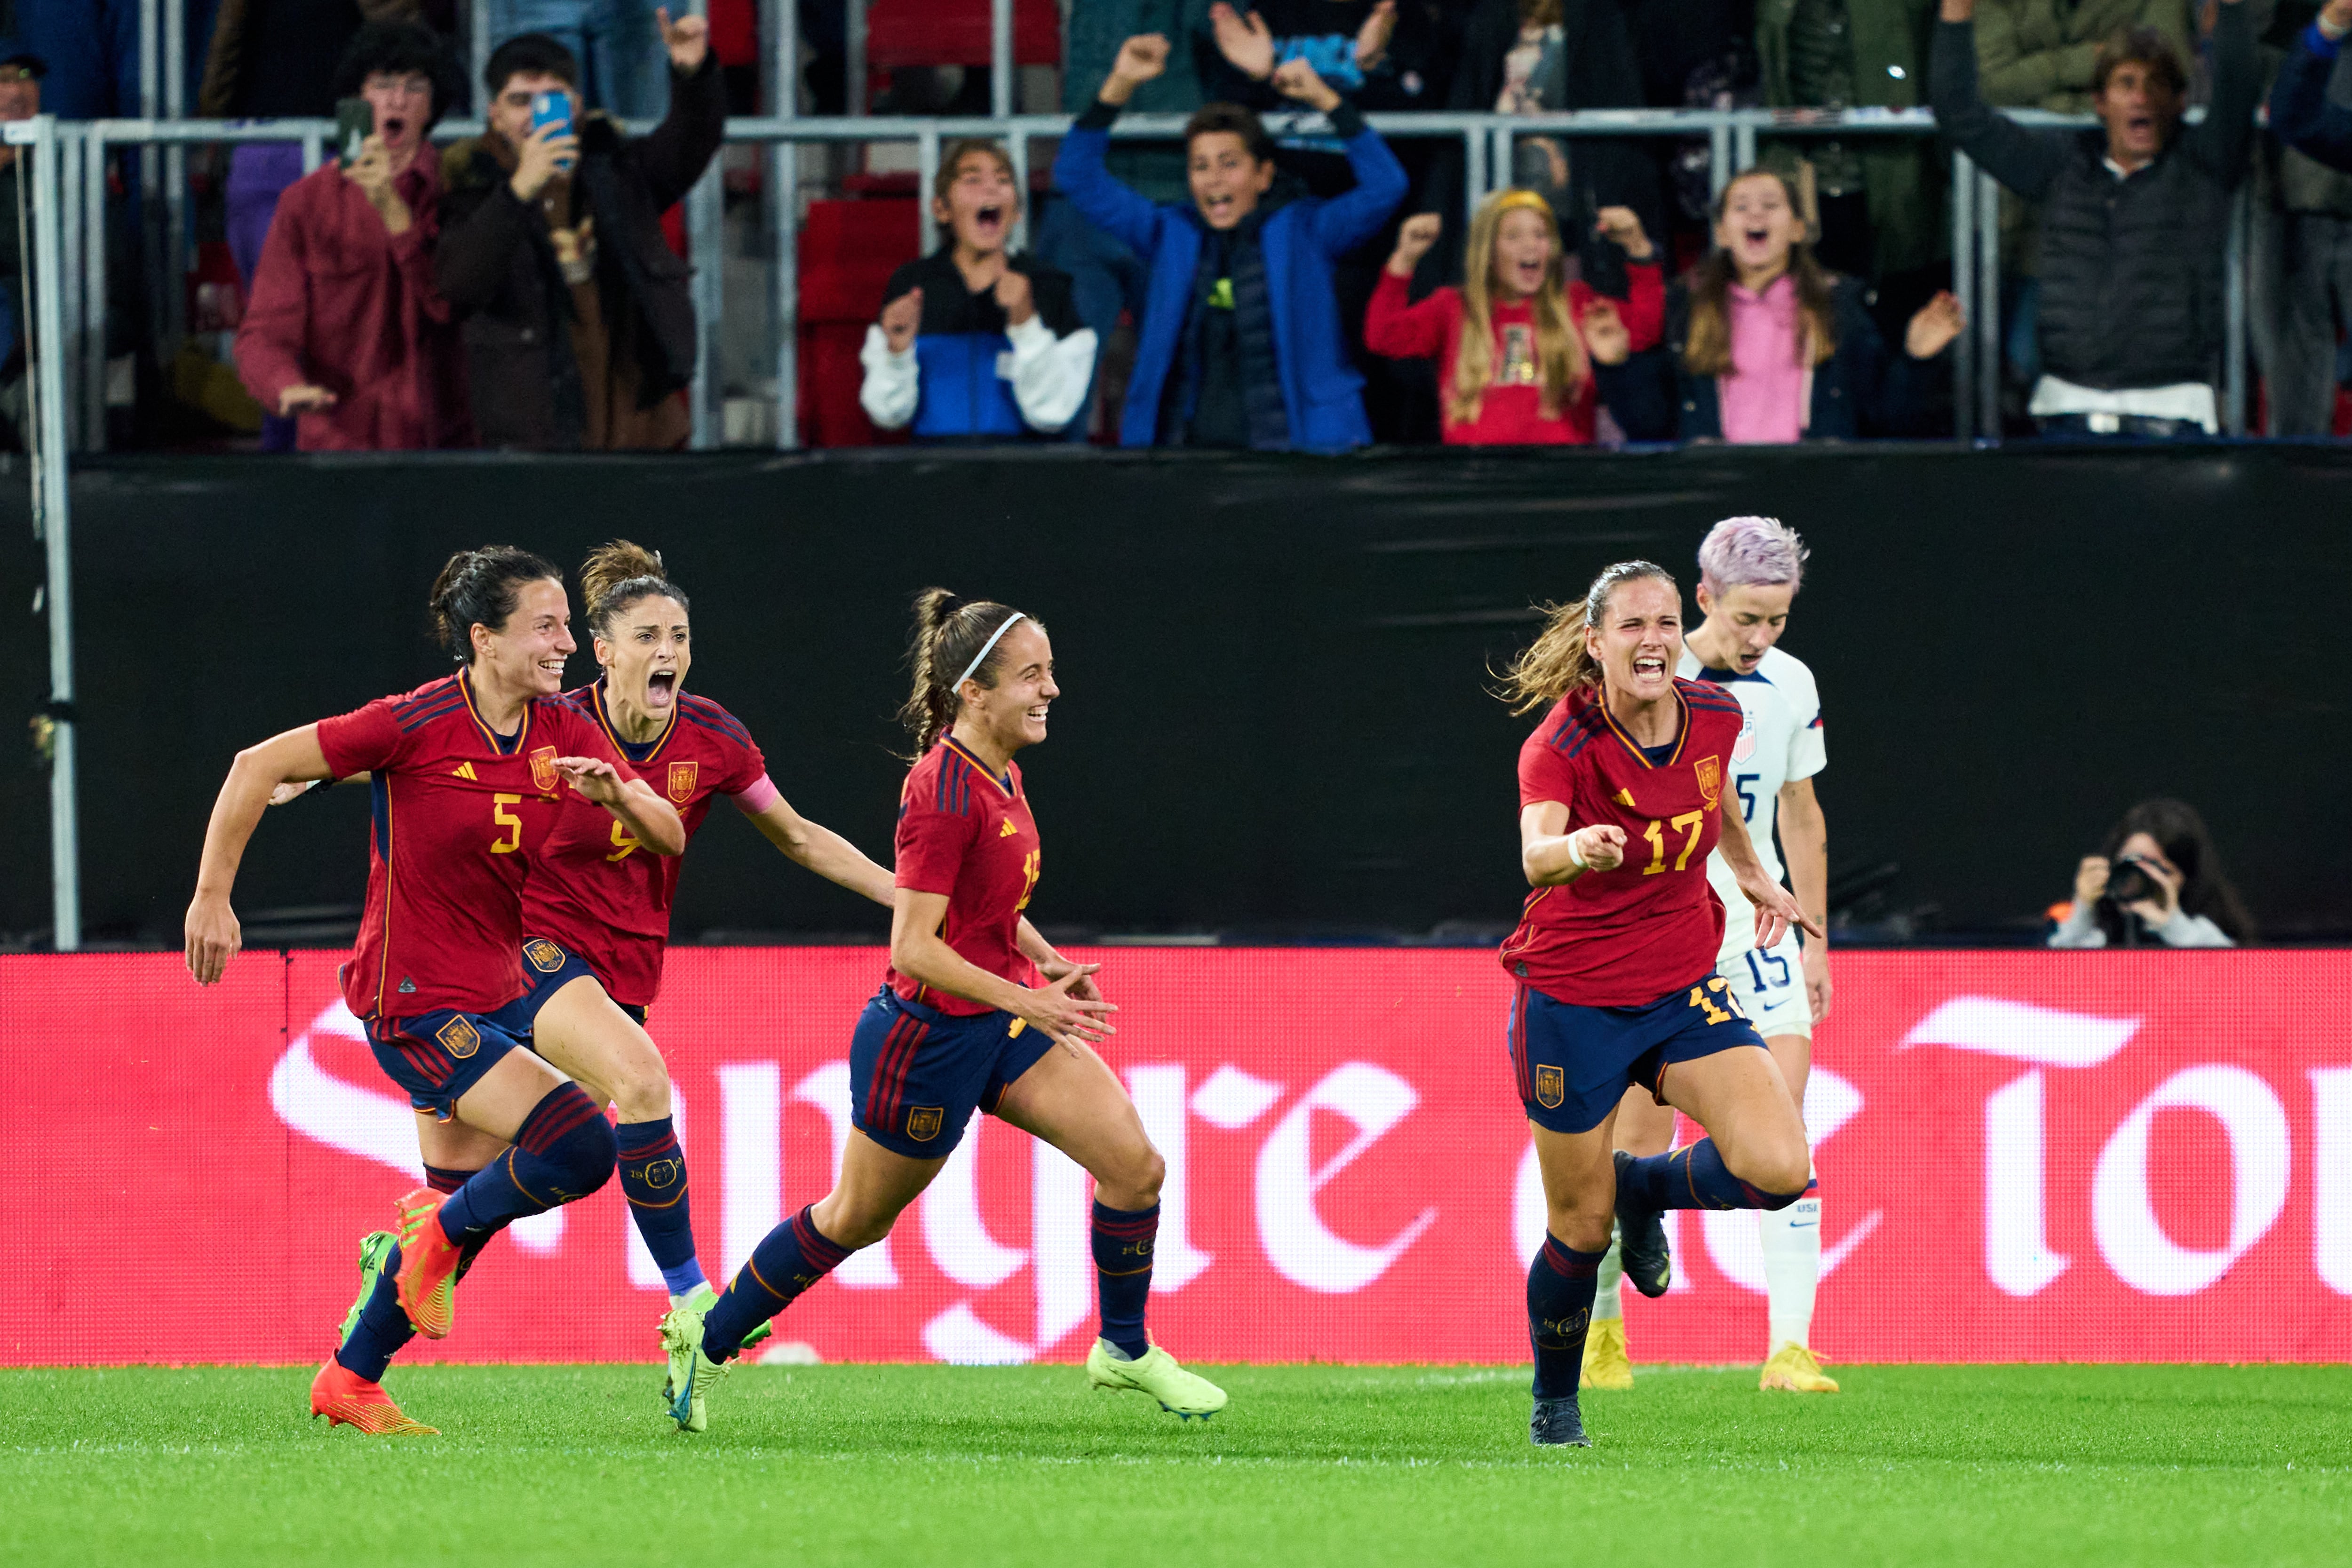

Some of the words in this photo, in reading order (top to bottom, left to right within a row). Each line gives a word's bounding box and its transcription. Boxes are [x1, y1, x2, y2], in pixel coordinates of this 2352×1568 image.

[490, 793, 522, 853] 5
[1642, 809, 1703, 876] 17
[1744, 946, 1791, 994] 15
[267, 995, 1440, 1365] Sngre
